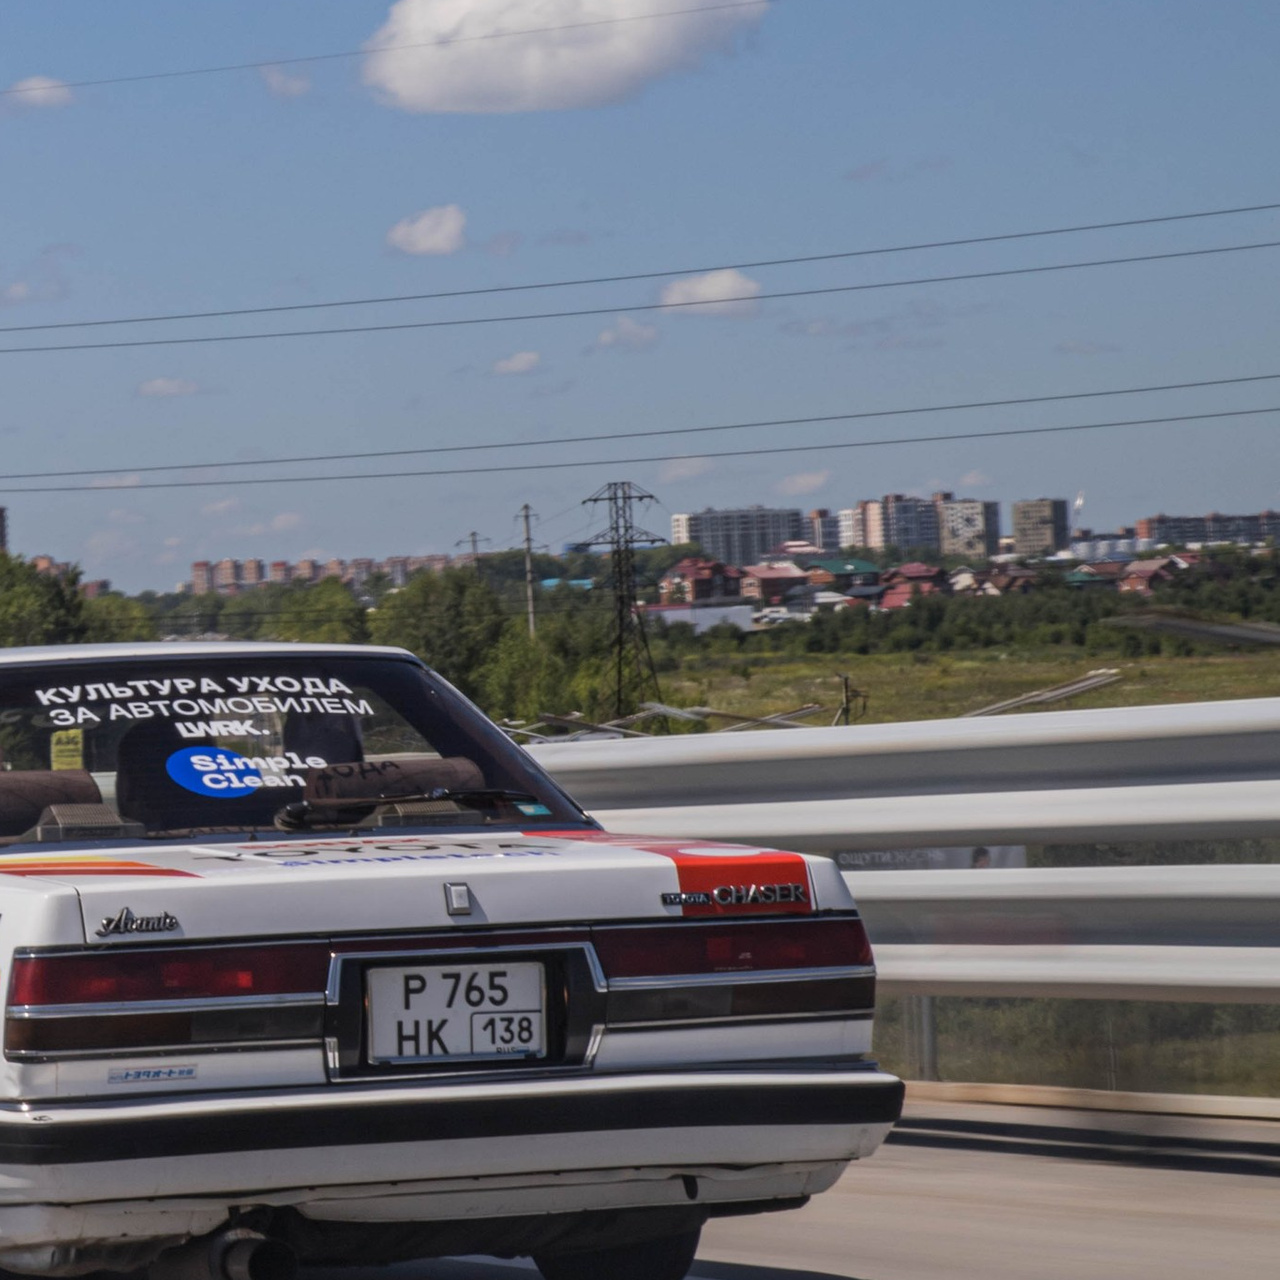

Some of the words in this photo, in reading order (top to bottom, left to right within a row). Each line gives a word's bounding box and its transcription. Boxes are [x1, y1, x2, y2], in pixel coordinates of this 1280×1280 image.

[35, 676, 225, 706] КУЛЬТУРА
[227, 676, 353, 696] УХОДА
[49, 706, 102, 726] ЗА
[109, 696, 376, 721] АВТОМОБИЛЕМ
[190, 751, 329, 772] Simple
[202, 773, 308, 790] Clean
[193, 842, 562, 862] TOYOTA
[662, 893, 711, 906] TOYOTA
[712, 883, 808, 904] CHASER
[404, 974, 427, 1010] P
[441, 971, 509, 1009] 765
[397, 1019, 450, 1056] HK
[482, 1016, 533, 1045] 138
